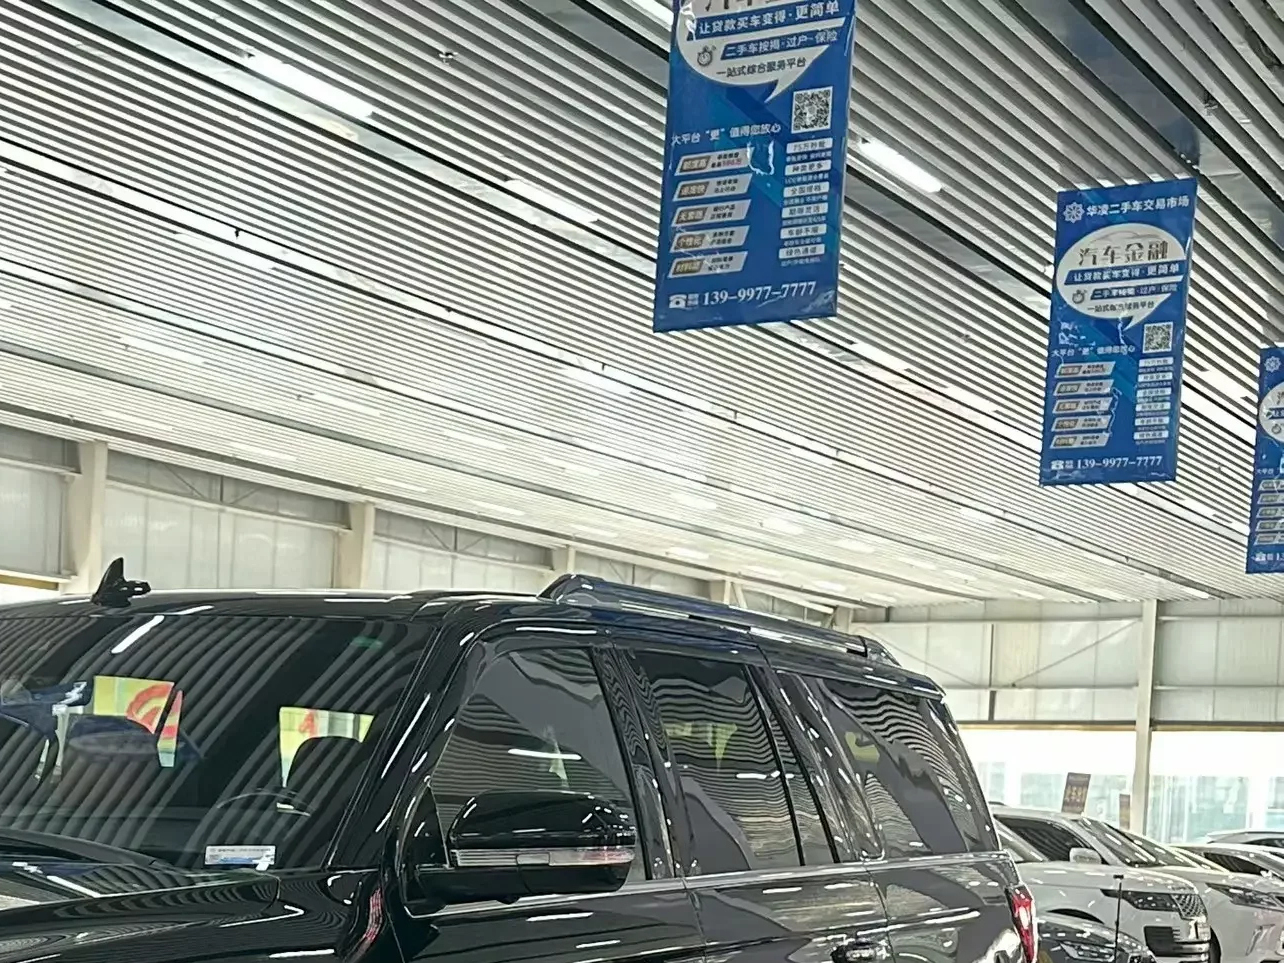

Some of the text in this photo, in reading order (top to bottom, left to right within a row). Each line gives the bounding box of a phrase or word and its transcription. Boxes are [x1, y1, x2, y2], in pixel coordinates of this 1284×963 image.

[1086, 195, 1189, 217] 华凌二手车交易市场
[1079, 240, 1169, 266] 汽车金融
[703, 280, 817, 306] 139-9977-7777
[1077, 456, 1163, 470] 139-9977-7777
